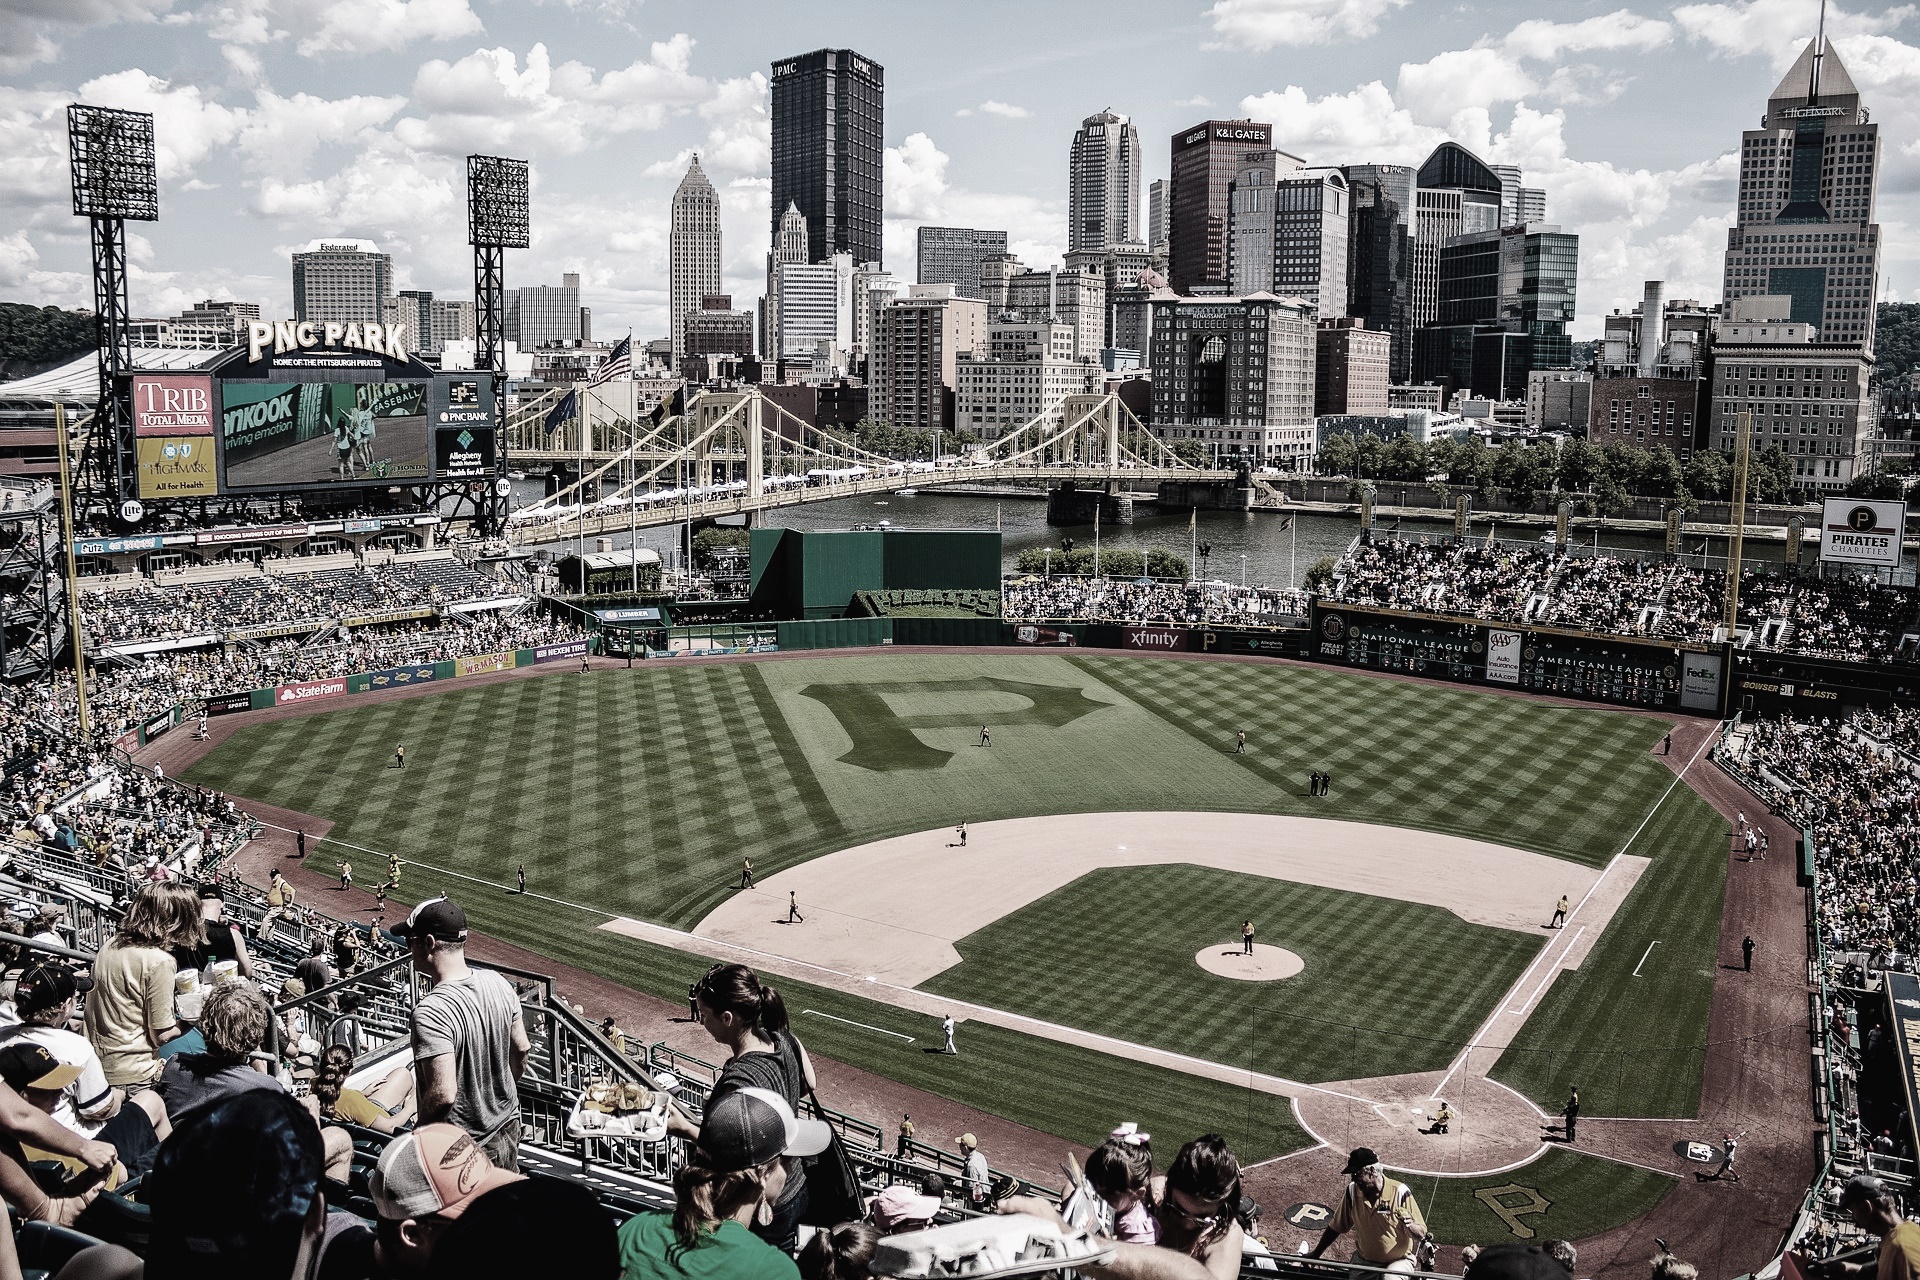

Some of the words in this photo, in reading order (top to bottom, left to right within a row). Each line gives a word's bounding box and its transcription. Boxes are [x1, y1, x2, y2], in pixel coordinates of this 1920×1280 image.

[853, 56, 871, 76] UPMC
[1783, 106, 1846, 119] HIGHMARK
[1216, 128, 1234, 138] K&L
[1234, 129, 1266, 140] GATES
[1389, 166, 1405, 174] PNC
[320, 243, 358, 252] Federated
[247, 320, 318, 364] PNC
[323, 321, 409, 364] PARK
[273, 358, 294, 367] HOME
[303, 359, 317, 367] THE
[317, 358, 356, 367] PITTSBURGH
[356, 359, 382, 367] PIRATES
[138, 382, 208, 413] TRIB
[140, 414, 176, 426] TOTAL
[176, 413, 209, 425] MEDIA
[449, 412, 466, 421] PNC
[466, 411, 489, 421] BANK
[225, 432, 254, 451] riving
[254, 420, 293, 442] emotion
[449, 452, 482, 461] Allegheny
[150, 462, 209, 475] HIGHMARK
[446, 469, 467, 477] Health
[466, 468, 475, 476] for
[474, 467, 485, 475] All
[156, 482, 167, 491] All
[168, 482, 179, 490] for
[180, 480, 204, 490] Health
[498, 483, 510, 493] Lite
[124, 505, 141, 517] Lite
[1669, 513, 1677, 533] Health
[1856, 512, 1869, 528] P
[214, 532, 241, 541] KNOCKING
[263, 530, 275, 538] OUT
[283, 528, 294, 536] THE
[1831, 534, 1889, 548] PIRATES
[1831, 544, 1888, 556] CHARITIES
[371, 614, 395, 624] LIGHT
[618, 610, 649, 618] LUMBER
[244, 629, 268, 639] IRON
[270, 627, 291, 636] CITY
[293, 623, 317, 633] BEER
[1131, 630, 1179, 648] xfinity
[1203, 632, 1217, 651] P
[1362, 633, 1420, 646] NATIONAL
[1424, 640, 1469, 653] LEAGUE
[547, 645, 571, 656] NEXEN
[571, 643, 587, 653] TIRE
[1320, 647, 1343, 656] FAST!
[1321, 642, 1345, 650] FREAKY
[1488, 660, 1519, 670] Insurance
[1496, 655, 1511, 663] Auto
[1537, 655, 1606, 670] AMERICAN
[1609, 664, 1662, 677] LEAGUE
[1489, 672, 1517, 681] AAA.com
[1686, 667, 1716, 680] FedEx
[1742, 681, 1779, 693] BOWSER
[1802, 689, 1838, 700] BLASTS
[227, 701, 249, 710] SPORTS
[1290, 1203, 1330, 1224] P
[1473, 1181, 1554, 1240] P
